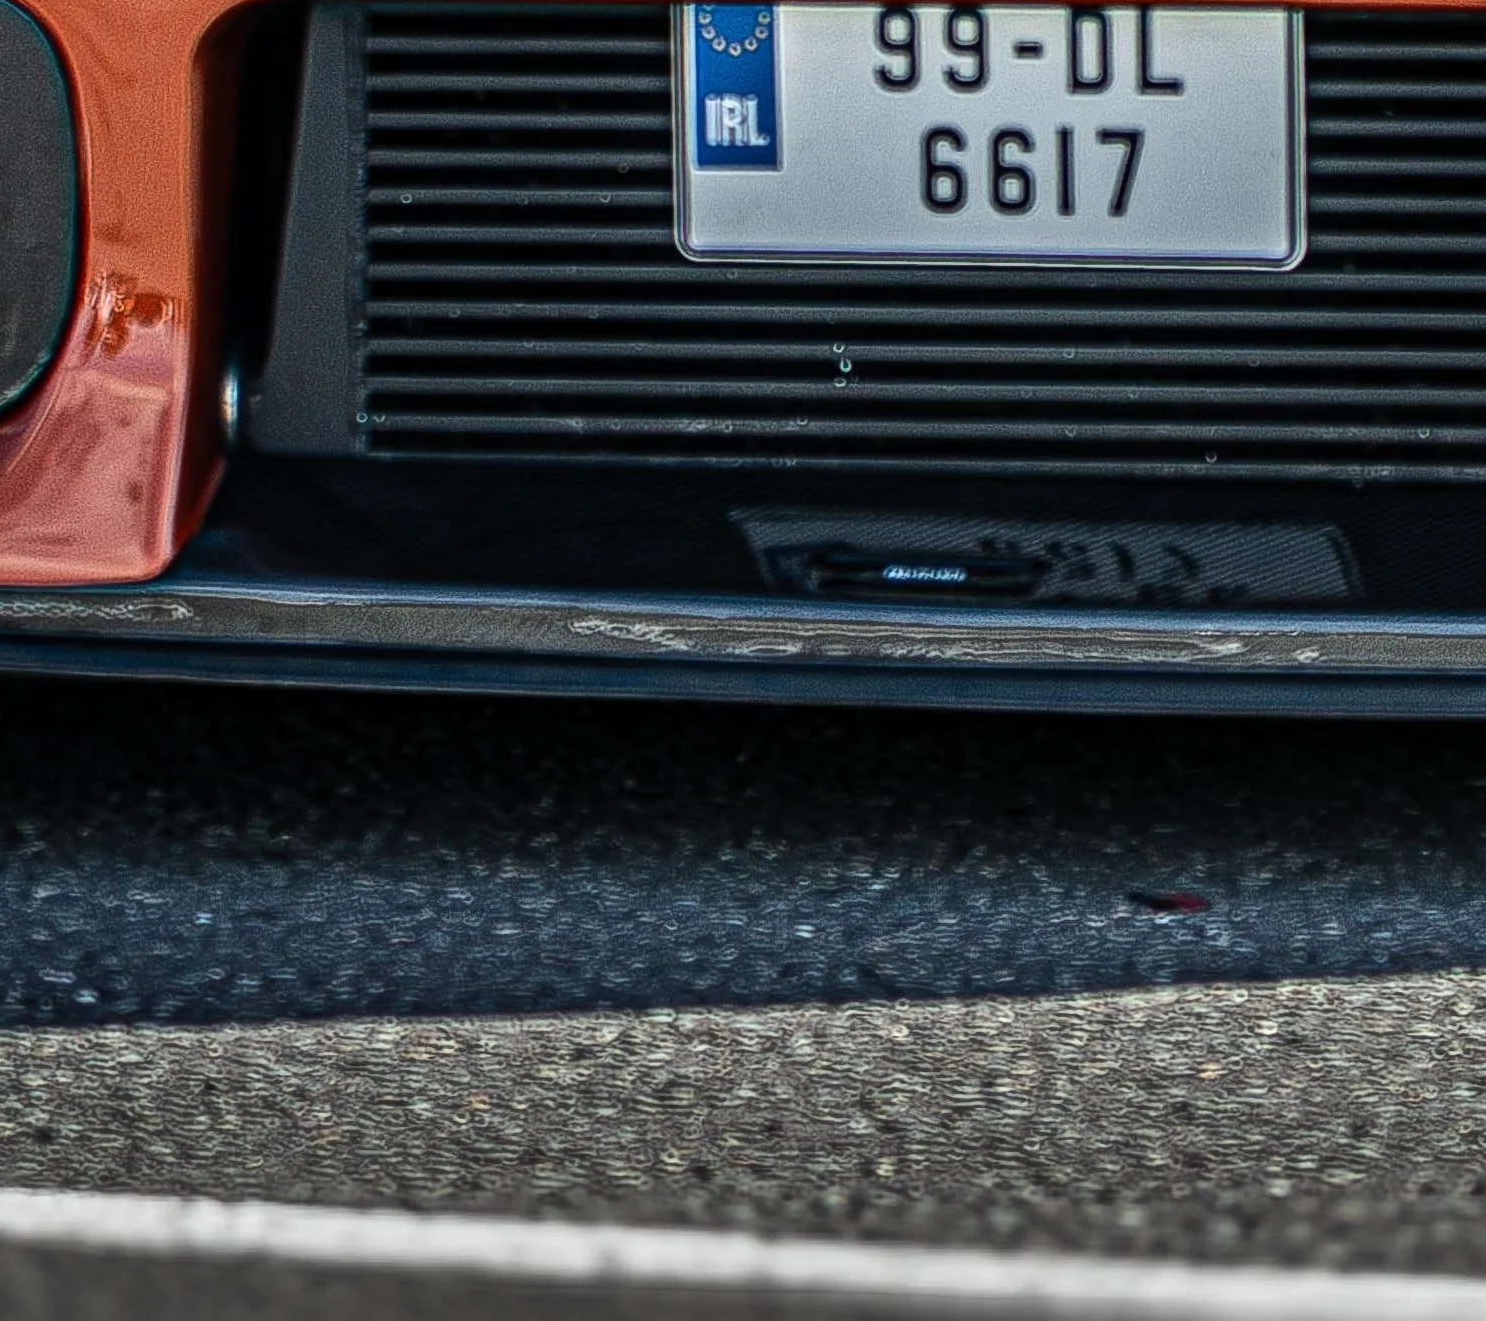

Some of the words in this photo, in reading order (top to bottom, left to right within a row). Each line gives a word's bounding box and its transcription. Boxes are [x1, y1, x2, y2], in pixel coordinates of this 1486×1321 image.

[872, 5, 1185, 95] 99-DL
[704, 92, 771, 148] IRL
[919, 125, 1146, 217] 6617
